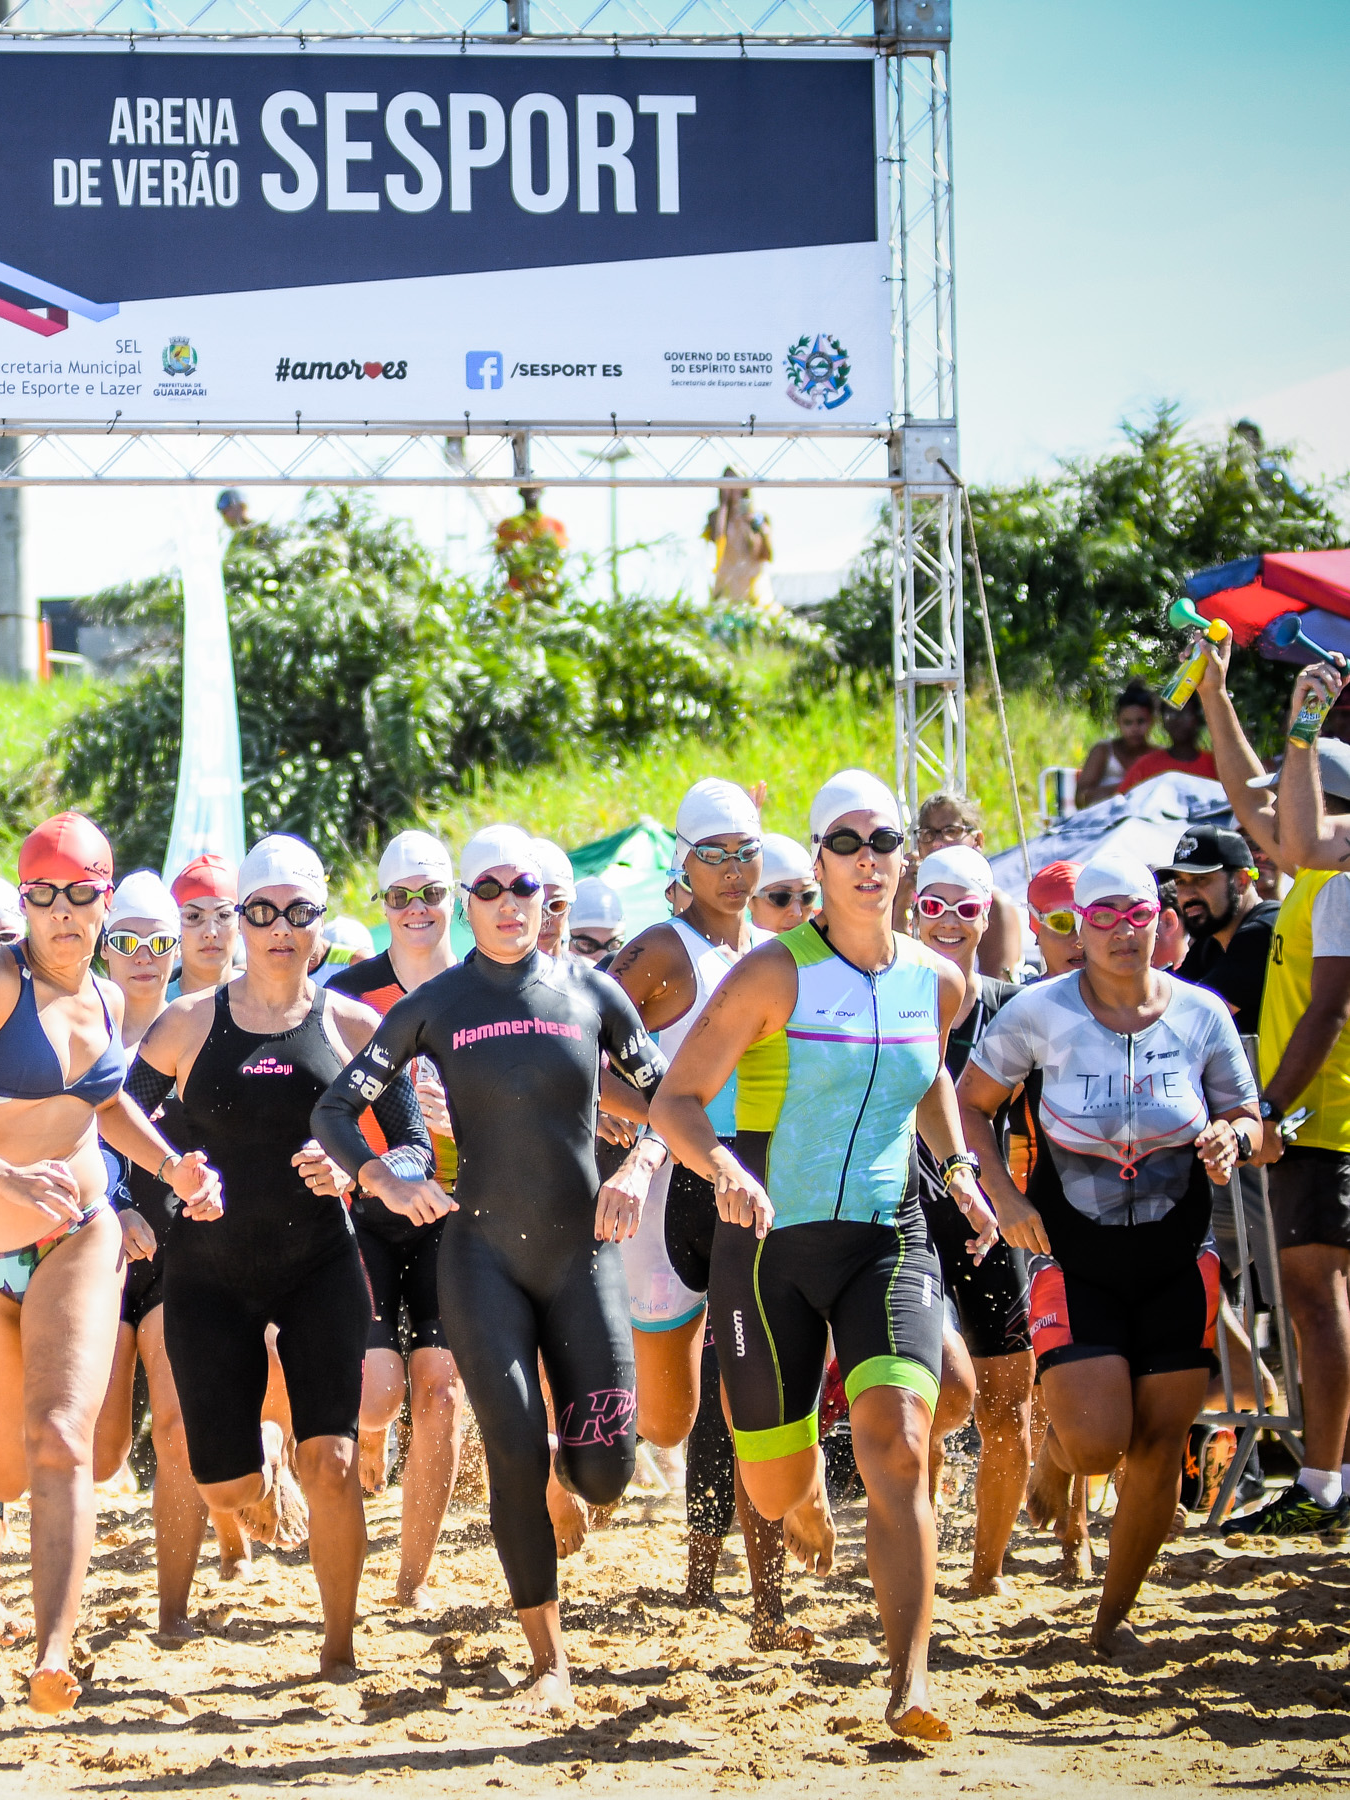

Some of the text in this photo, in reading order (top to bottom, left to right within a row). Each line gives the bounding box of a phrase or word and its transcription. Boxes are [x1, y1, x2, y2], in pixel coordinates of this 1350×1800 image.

[108, 97, 239, 146] ARENA
[260, 89, 697, 214] SESPORT
[53, 150, 239, 207] DE VERÃO
[115, 339, 142, 354] SEL
[664, 352, 772, 361] GOVERNO DO ESTADO
[68, 360, 142, 377] Municipal
[511, 362, 623, 378] /SESPORT ES
[671, 362, 772, 374] DO ESPÍRITO SANTO
[22, 381, 80, 398] Esporte
[85, 385, 94, 395] e
[100, 381, 142, 395] Lazer
[153, 388, 207, 396] GUARAPARI
[452, 1017, 582, 1050] Hammerhead
[1076, 1071, 1183, 1100] TIME
[732, 1309, 746, 1358] woom
